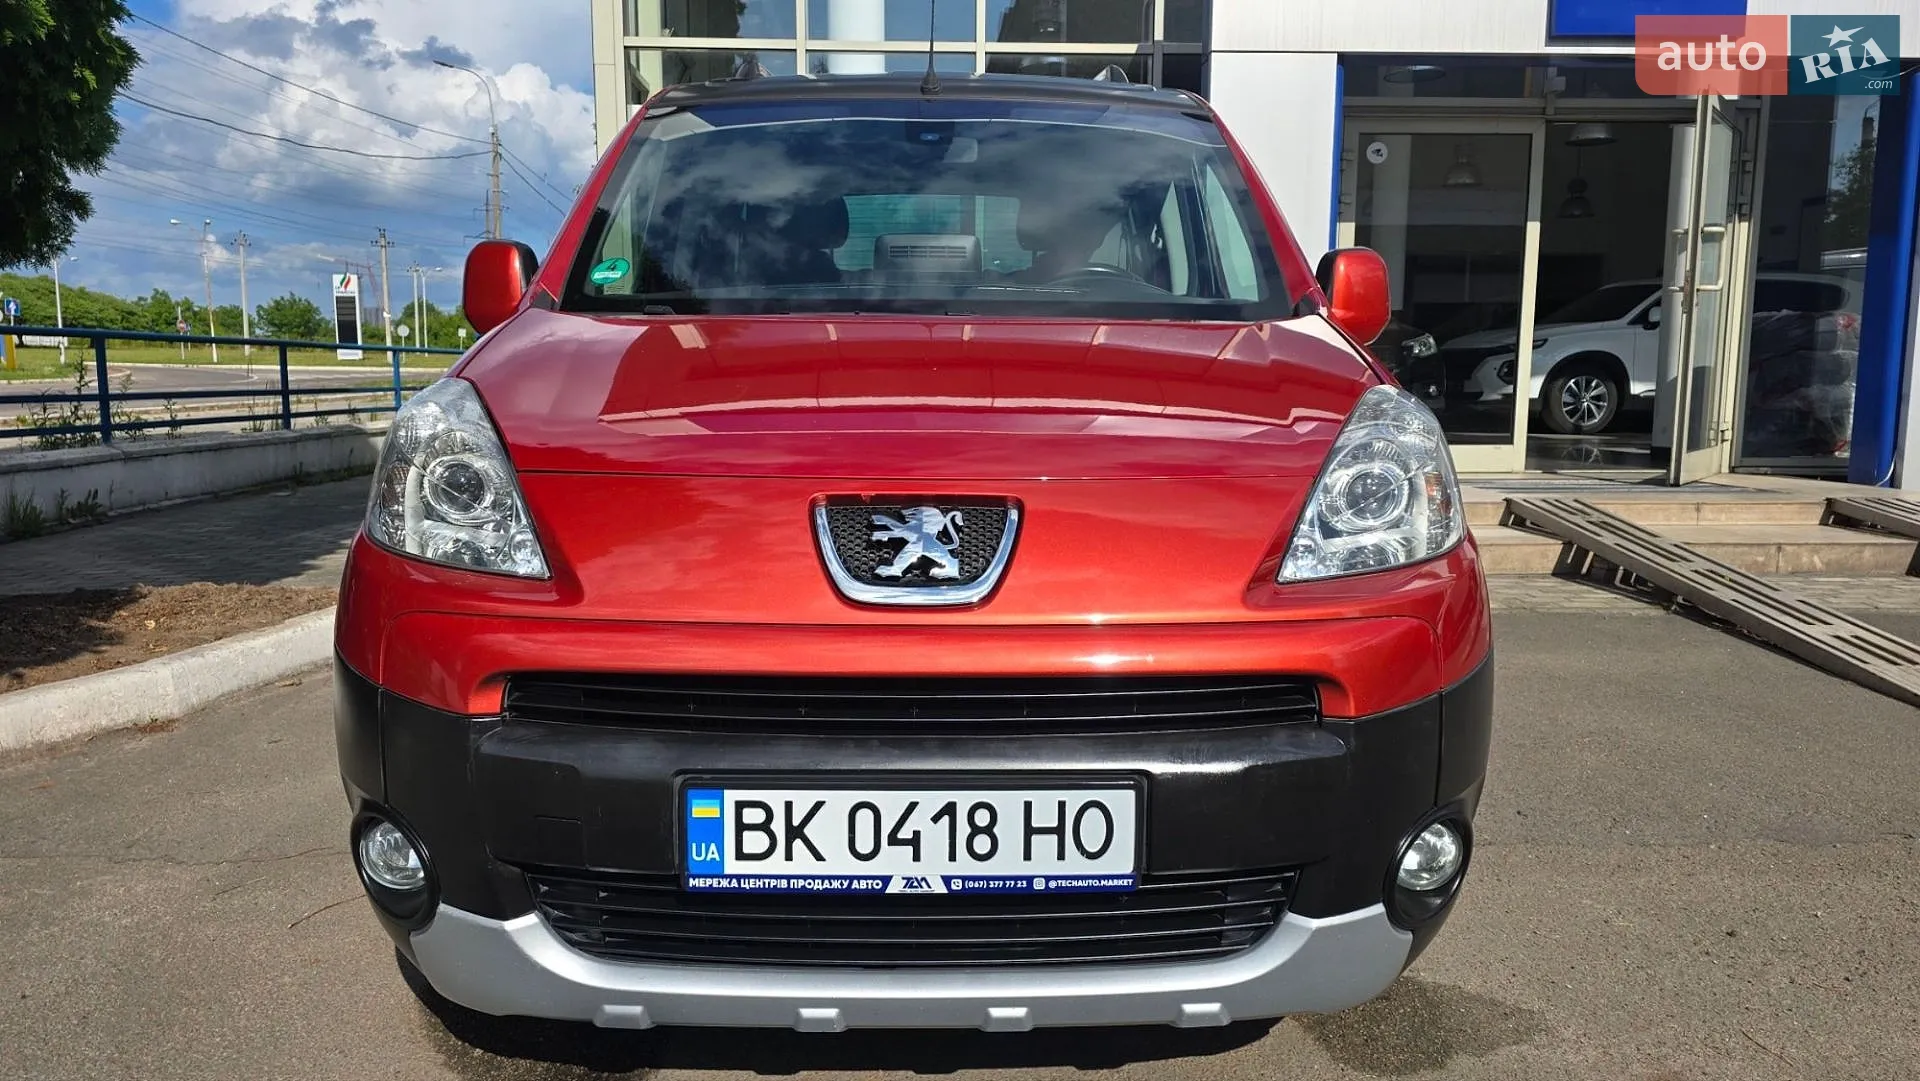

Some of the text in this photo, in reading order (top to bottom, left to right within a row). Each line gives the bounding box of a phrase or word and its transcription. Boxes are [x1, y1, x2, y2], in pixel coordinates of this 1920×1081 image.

[734, 799, 1115, 862] BK 0418 HO
[691, 842, 720, 862] UA
[689, 877, 883, 890] МЕРЕЖА ЦЕНТРІВ ПРОДАЖУ АВТО
[965, 880, 987, 889] (067)
[1048, 879, 1134, 889] @TECHAUTO.MARKET
